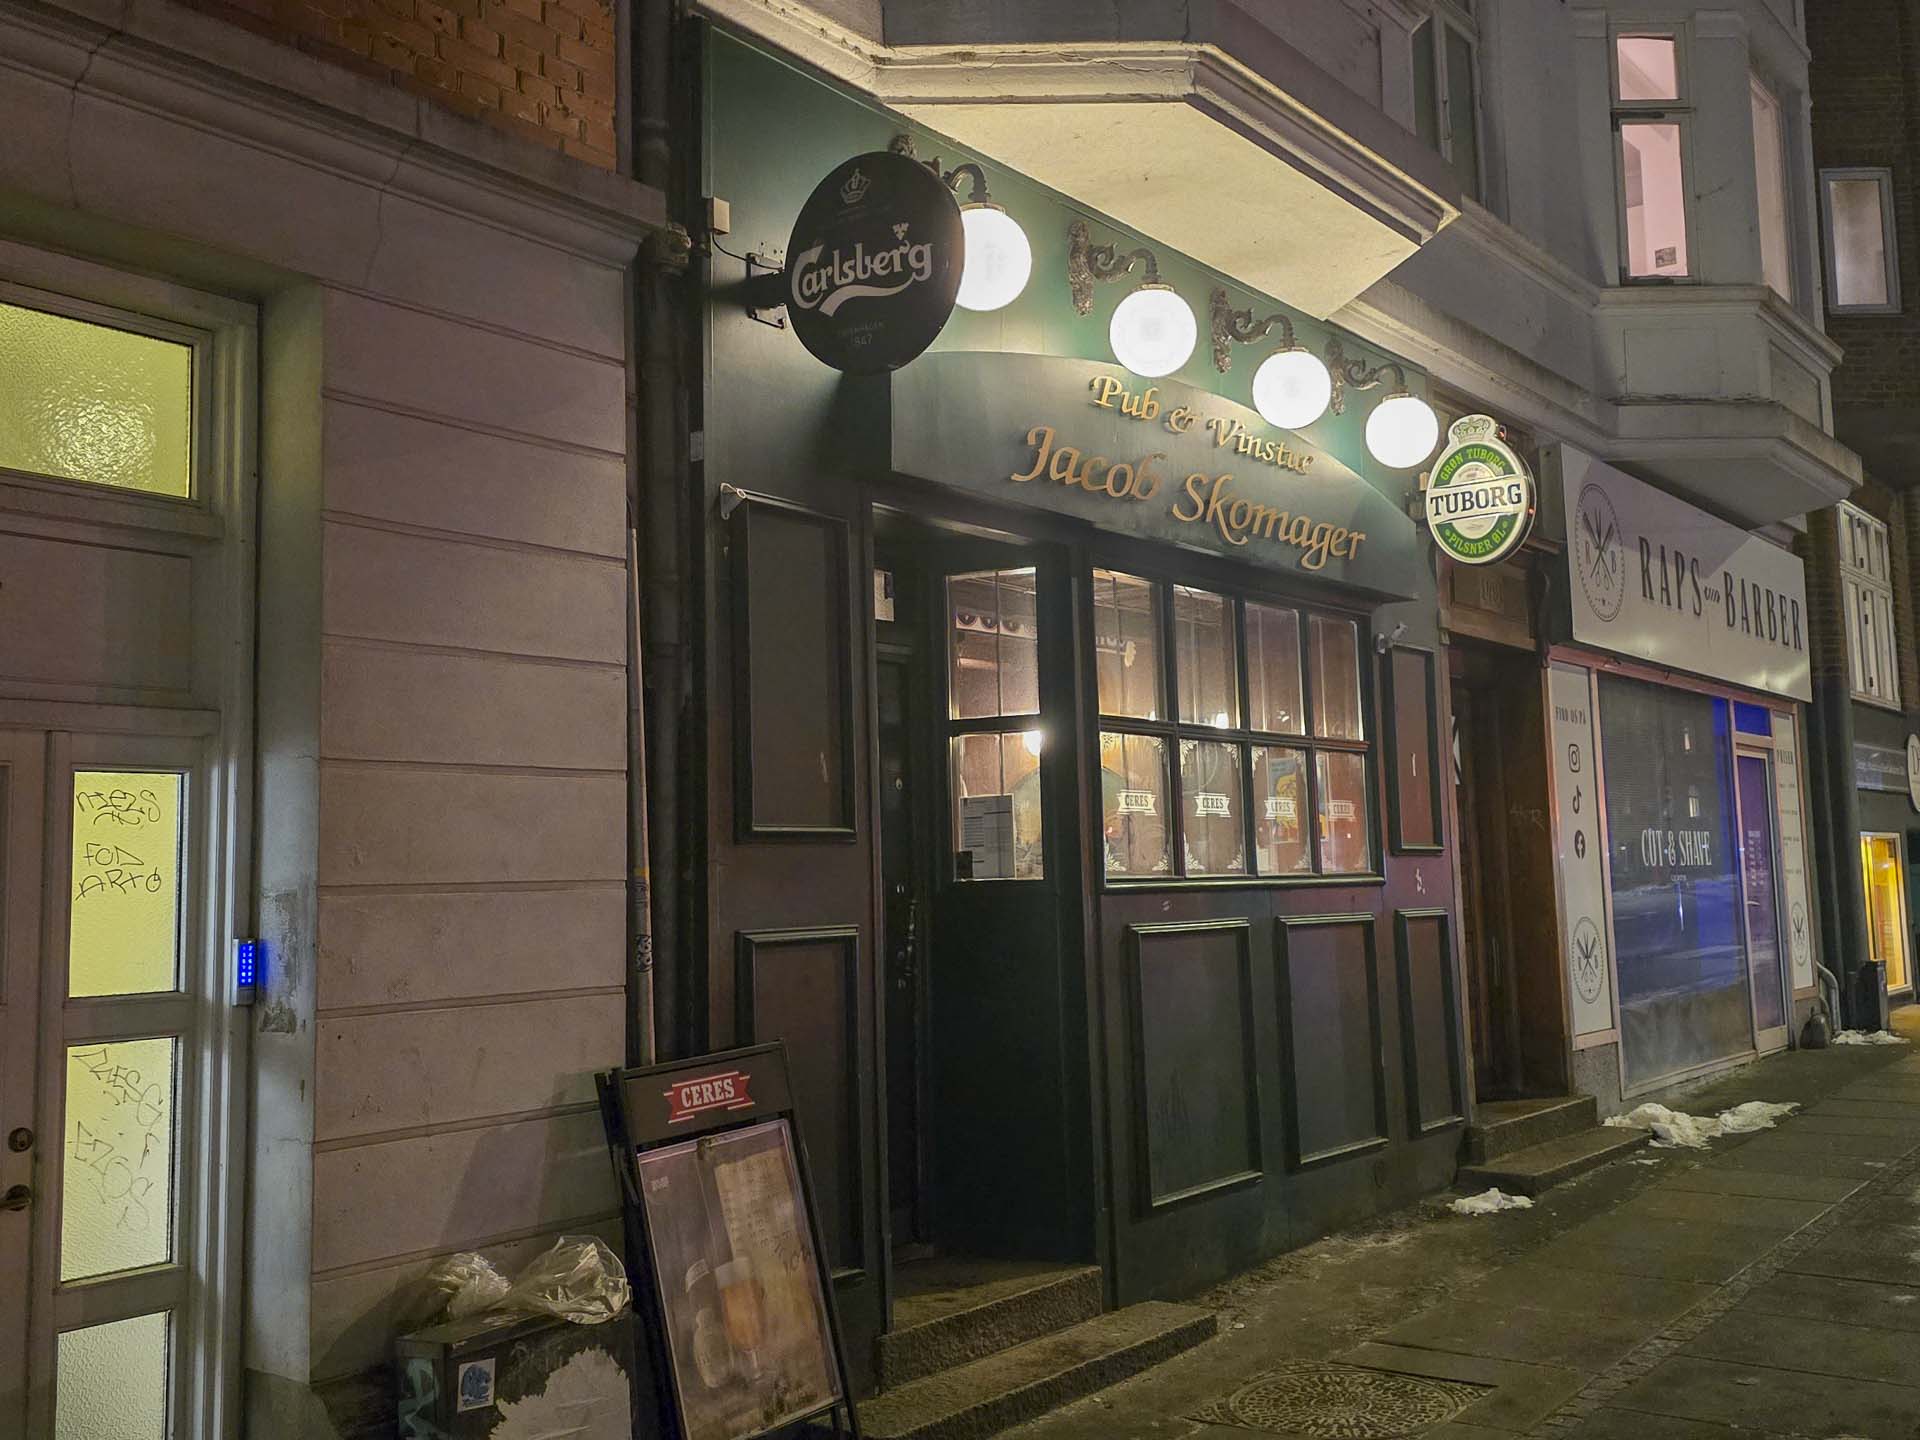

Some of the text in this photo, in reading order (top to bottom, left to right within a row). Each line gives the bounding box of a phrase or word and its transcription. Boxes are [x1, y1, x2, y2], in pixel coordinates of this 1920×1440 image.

[791, 242, 933, 312] Carlsberg
[1090, 375, 1314, 475] Pub & Vinstue
[1441, 453, 1464, 480] GRØN
[1467, 448, 1506, 470] TUBORG
[1010, 426, 1366, 570] Jacob Skomager
[1430, 483, 1522, 516] TUBORG
[1449, 528, 1506, 554] PILSNER ØL
[1638, 535, 1702, 617] RAPS
[1723, 571, 1803, 650] BARBER
[1124, 793, 1149, 808] CERES
[1202, 796, 1225, 809] CERES
[1641, 829, 1664, 867] CUT
[1668, 830, 1677, 867] &
[1679, 830, 1713, 867] SHAVE
[681, 1079, 735, 1108] CERES
